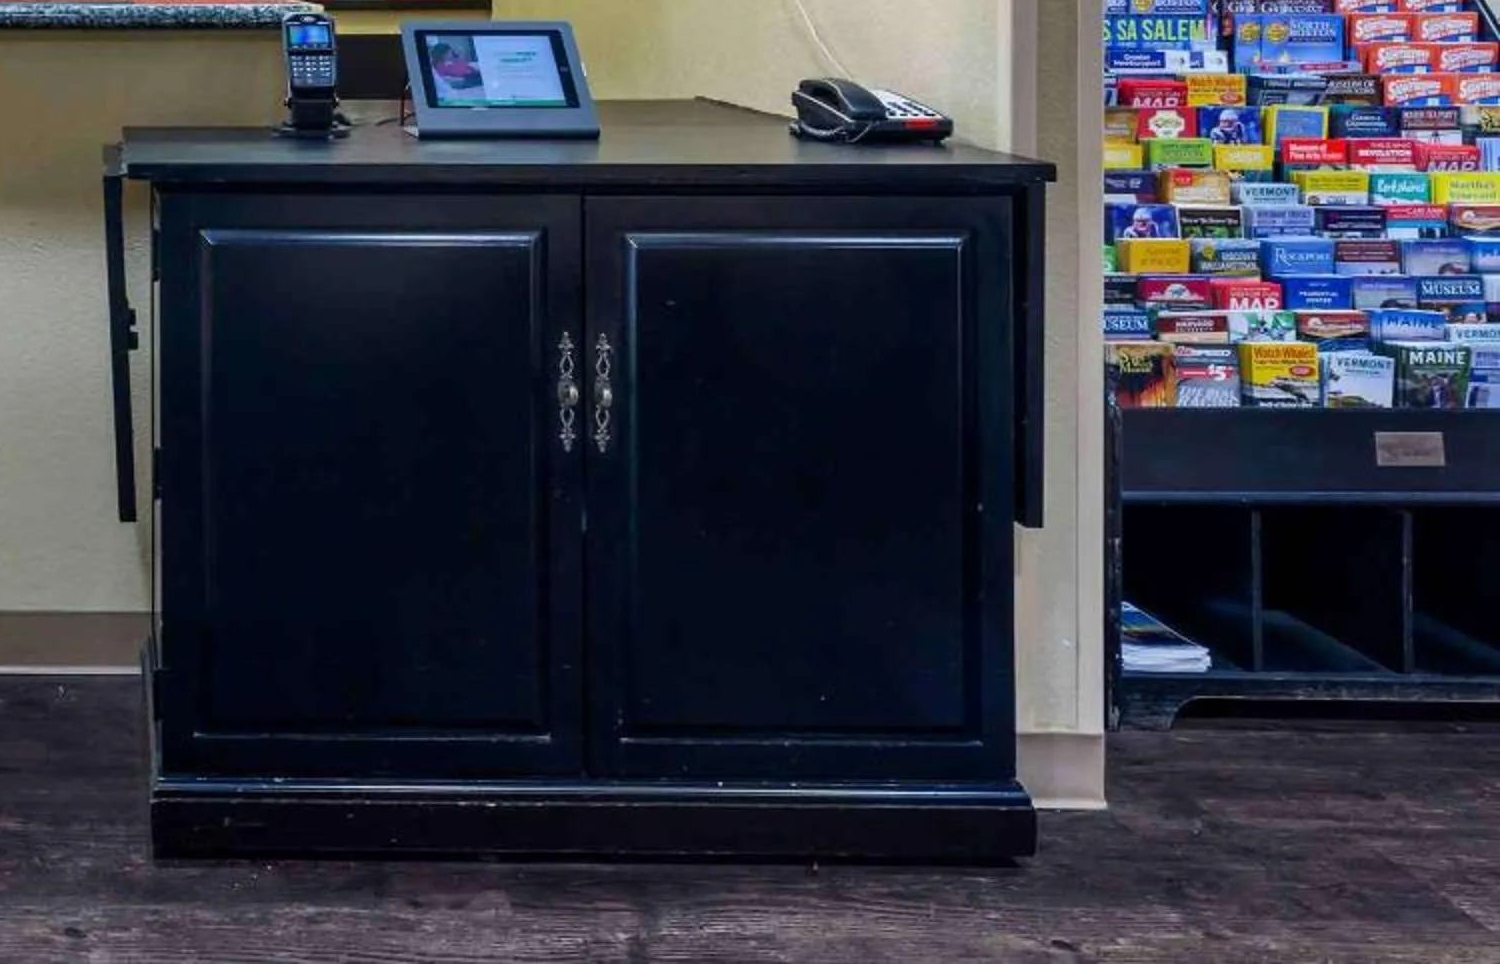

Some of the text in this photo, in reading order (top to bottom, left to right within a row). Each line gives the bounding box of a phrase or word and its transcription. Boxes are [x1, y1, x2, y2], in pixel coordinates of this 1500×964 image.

[1142, 20, 1205, 41] SALEM
[1133, 96, 1179, 107] MAP
[1427, 161, 1476, 172] MAP
[1245, 187, 1297, 196] VERMONT
[1421, 280, 1481, 295] MUSEUM
[1230, 297, 1280, 310] MAP
[1104, 316, 1149, 330] USEUM
[1338, 356, 1392, 369] VERMONT
[1409, 351, 1467, 365] MAINE
